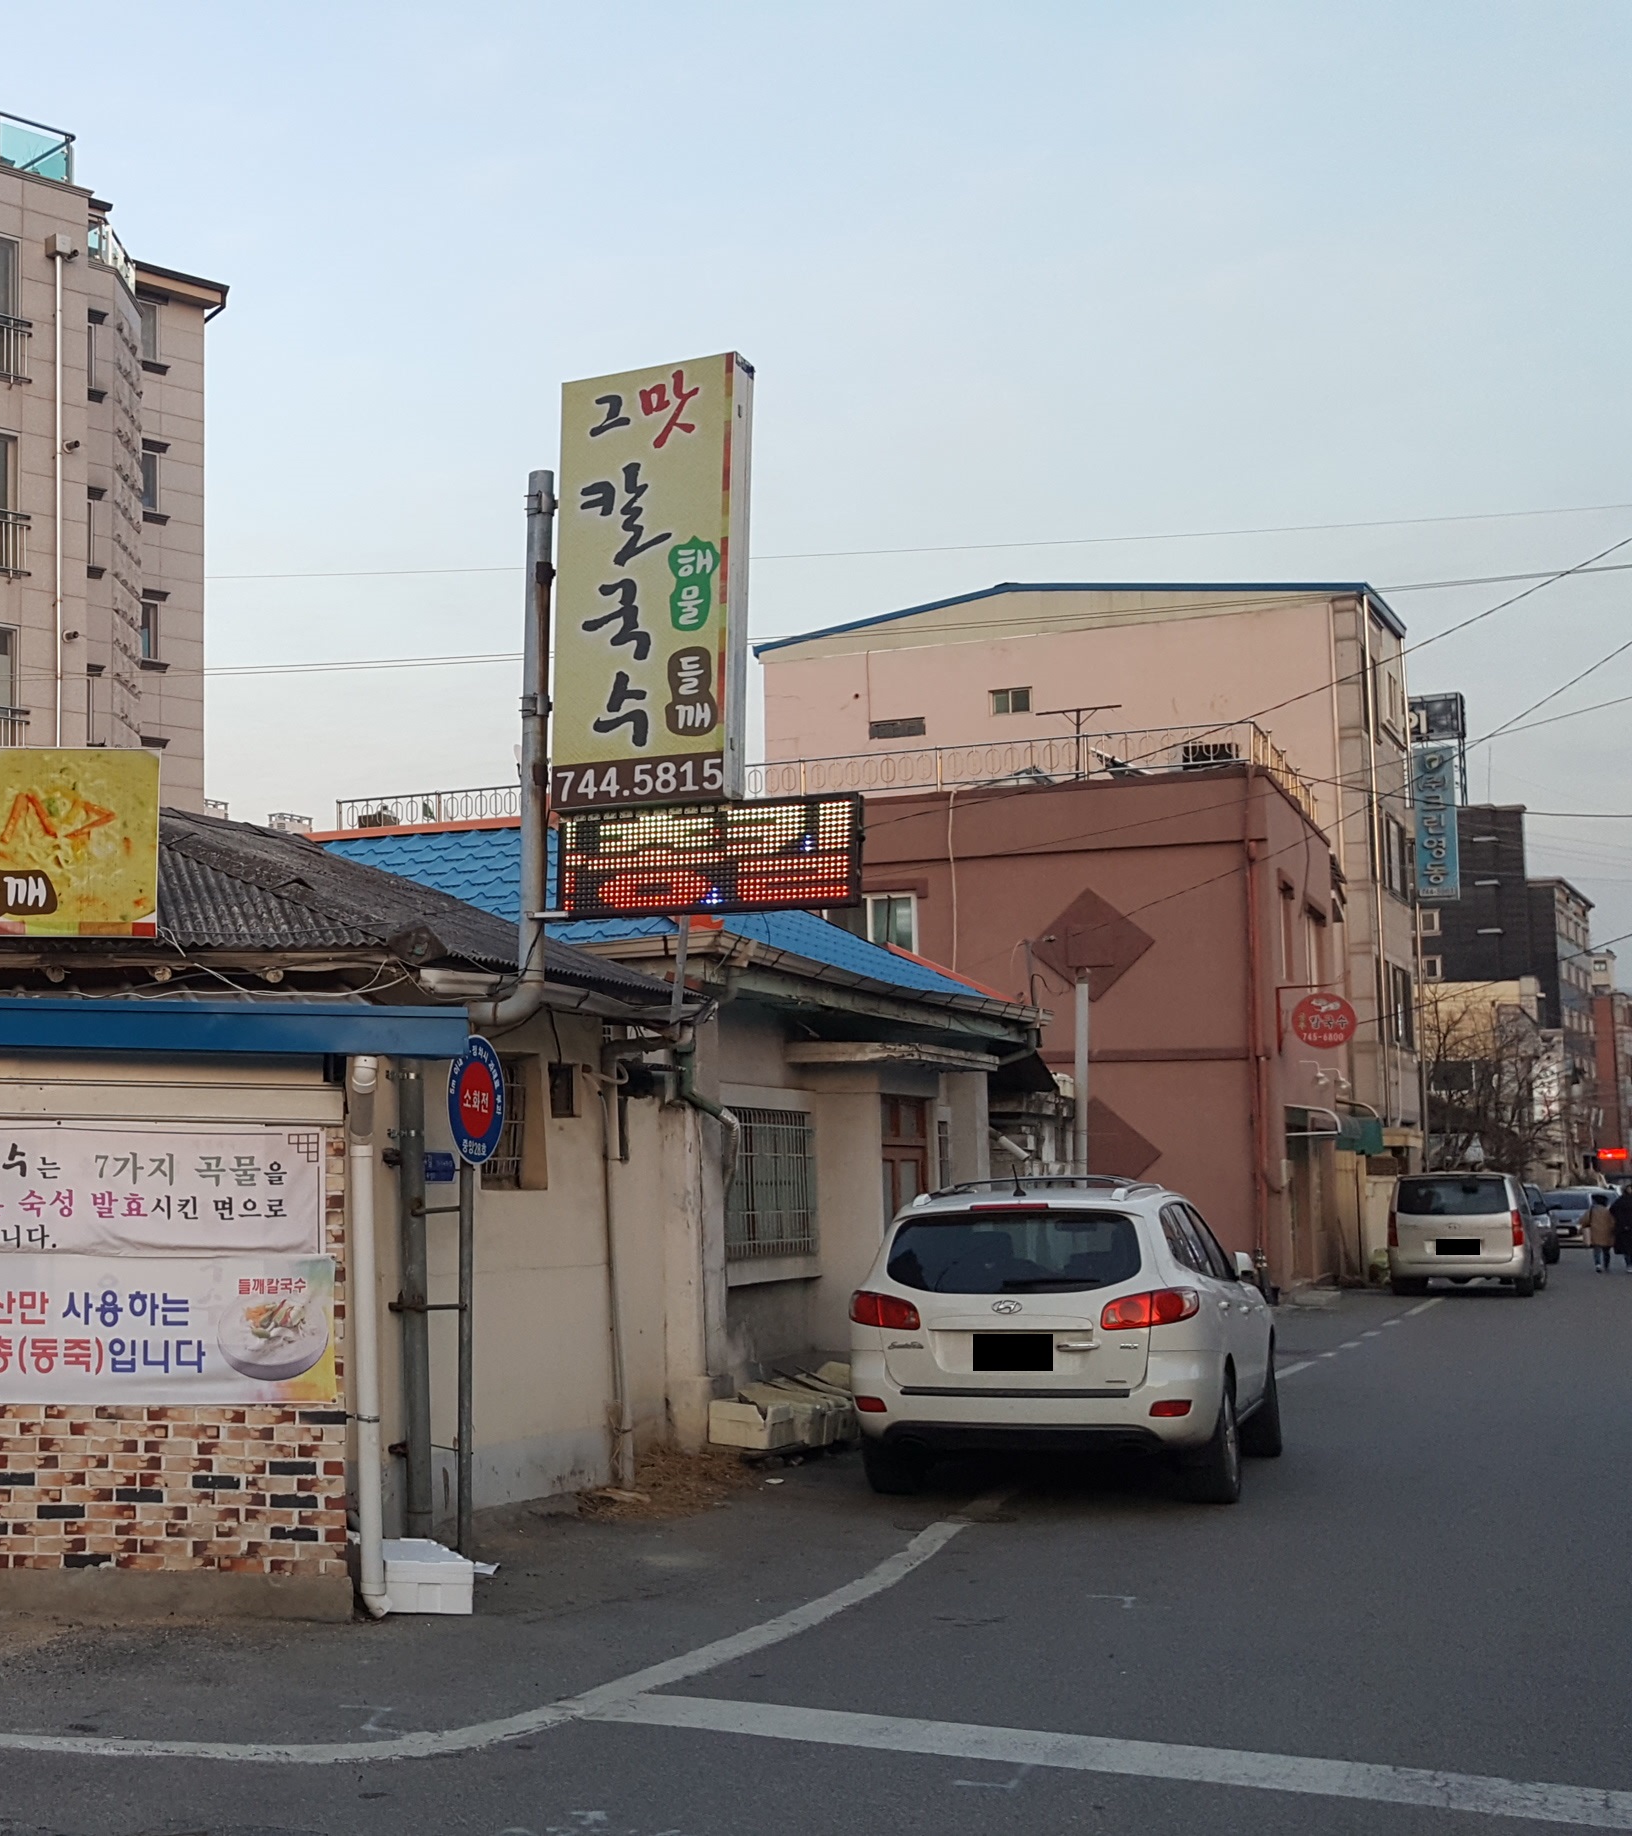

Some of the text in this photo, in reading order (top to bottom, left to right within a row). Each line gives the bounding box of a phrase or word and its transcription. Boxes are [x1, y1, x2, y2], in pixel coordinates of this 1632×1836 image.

[579, 462, 672, 747] 칼국수
[676, 547, 715, 626] 해물
[675, 653, 712, 731] 들깨
[556, 757, 724, 803] 744.5815
[462, 1088, 489, 1114] 소화전
[94, 1151, 177, 1187] 7가지
[194, 1154, 288, 1187] 곡물을
[17, 1188, 74, 1218] 숙성
[90, 1191, 200, 1221] 발효시킨
[212, 1196, 288, 1221] 면으로
[61, 1290, 190, 1328] 사용하는
